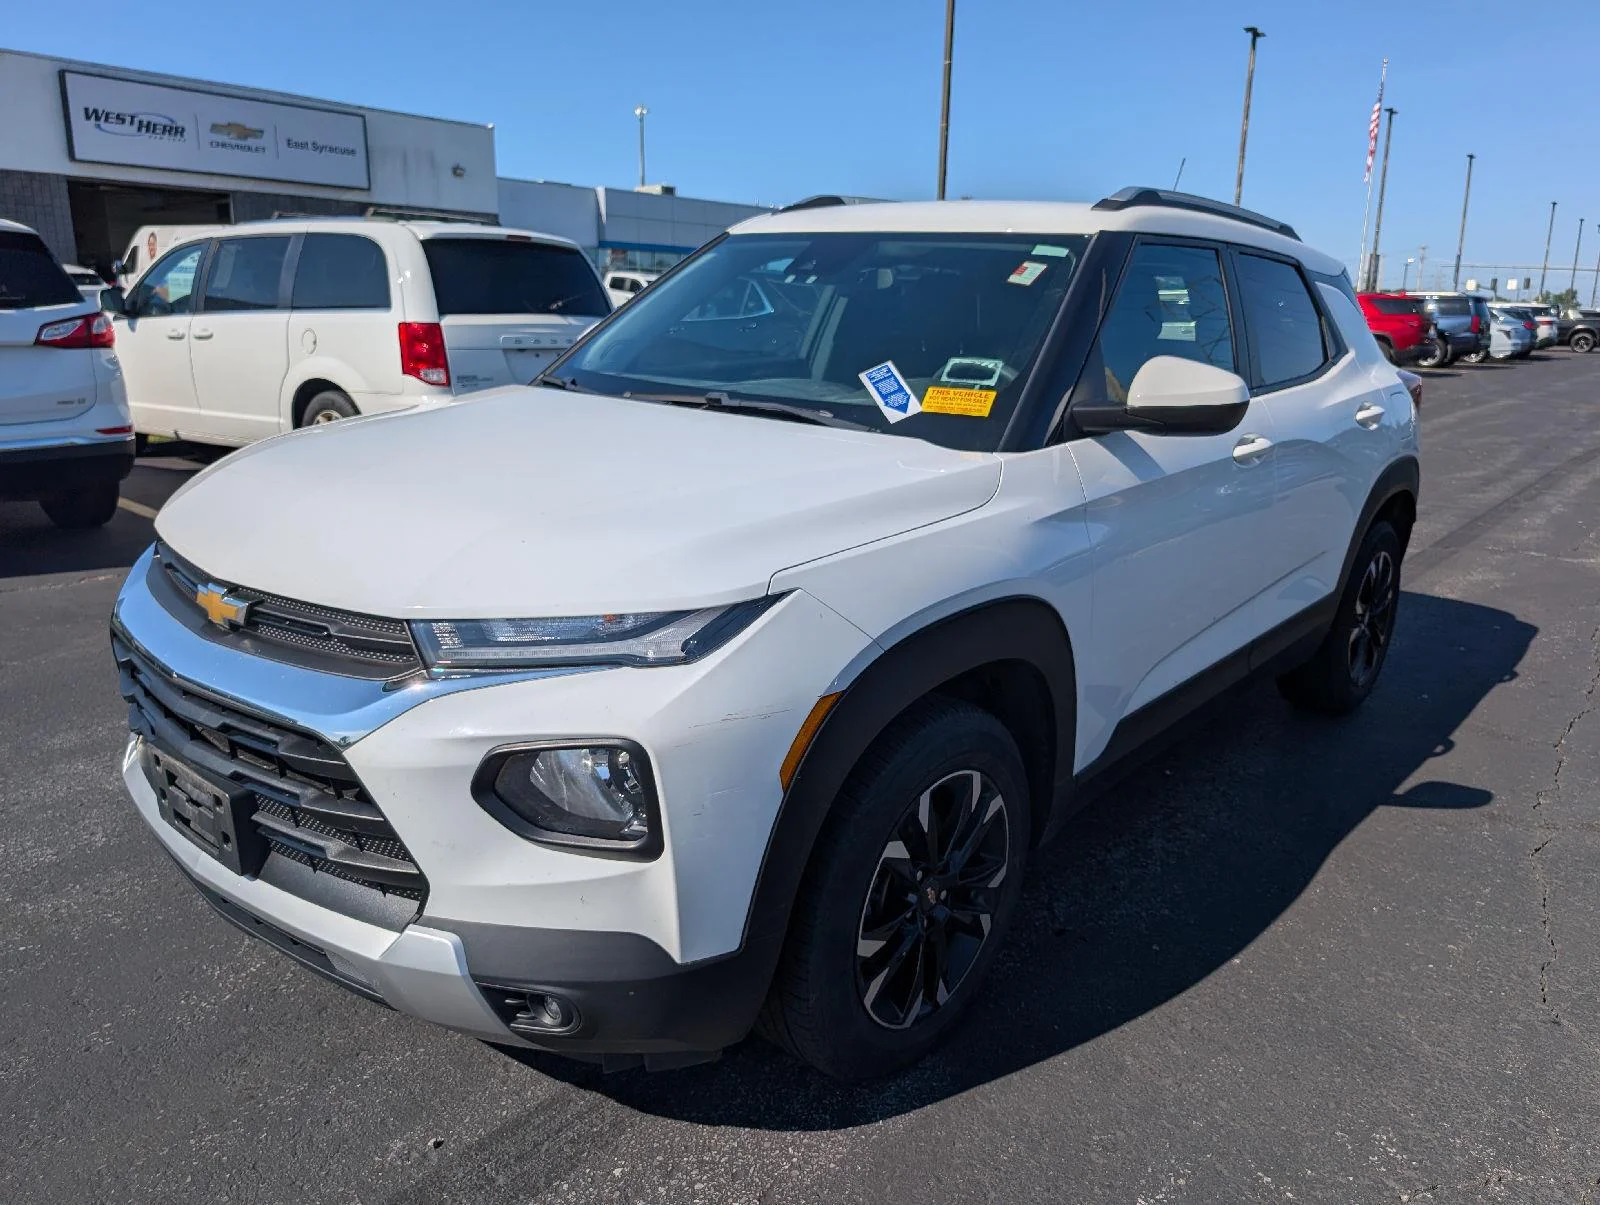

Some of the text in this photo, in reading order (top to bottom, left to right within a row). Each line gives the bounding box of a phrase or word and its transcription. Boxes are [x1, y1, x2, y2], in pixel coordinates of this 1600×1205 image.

[83, 106, 187, 138] WEST HERR
[209, 141, 266, 154] CHEVROLET
[287, 137, 357, 156] East Syracuse
[953, 390, 991, 399] VEHICLE
